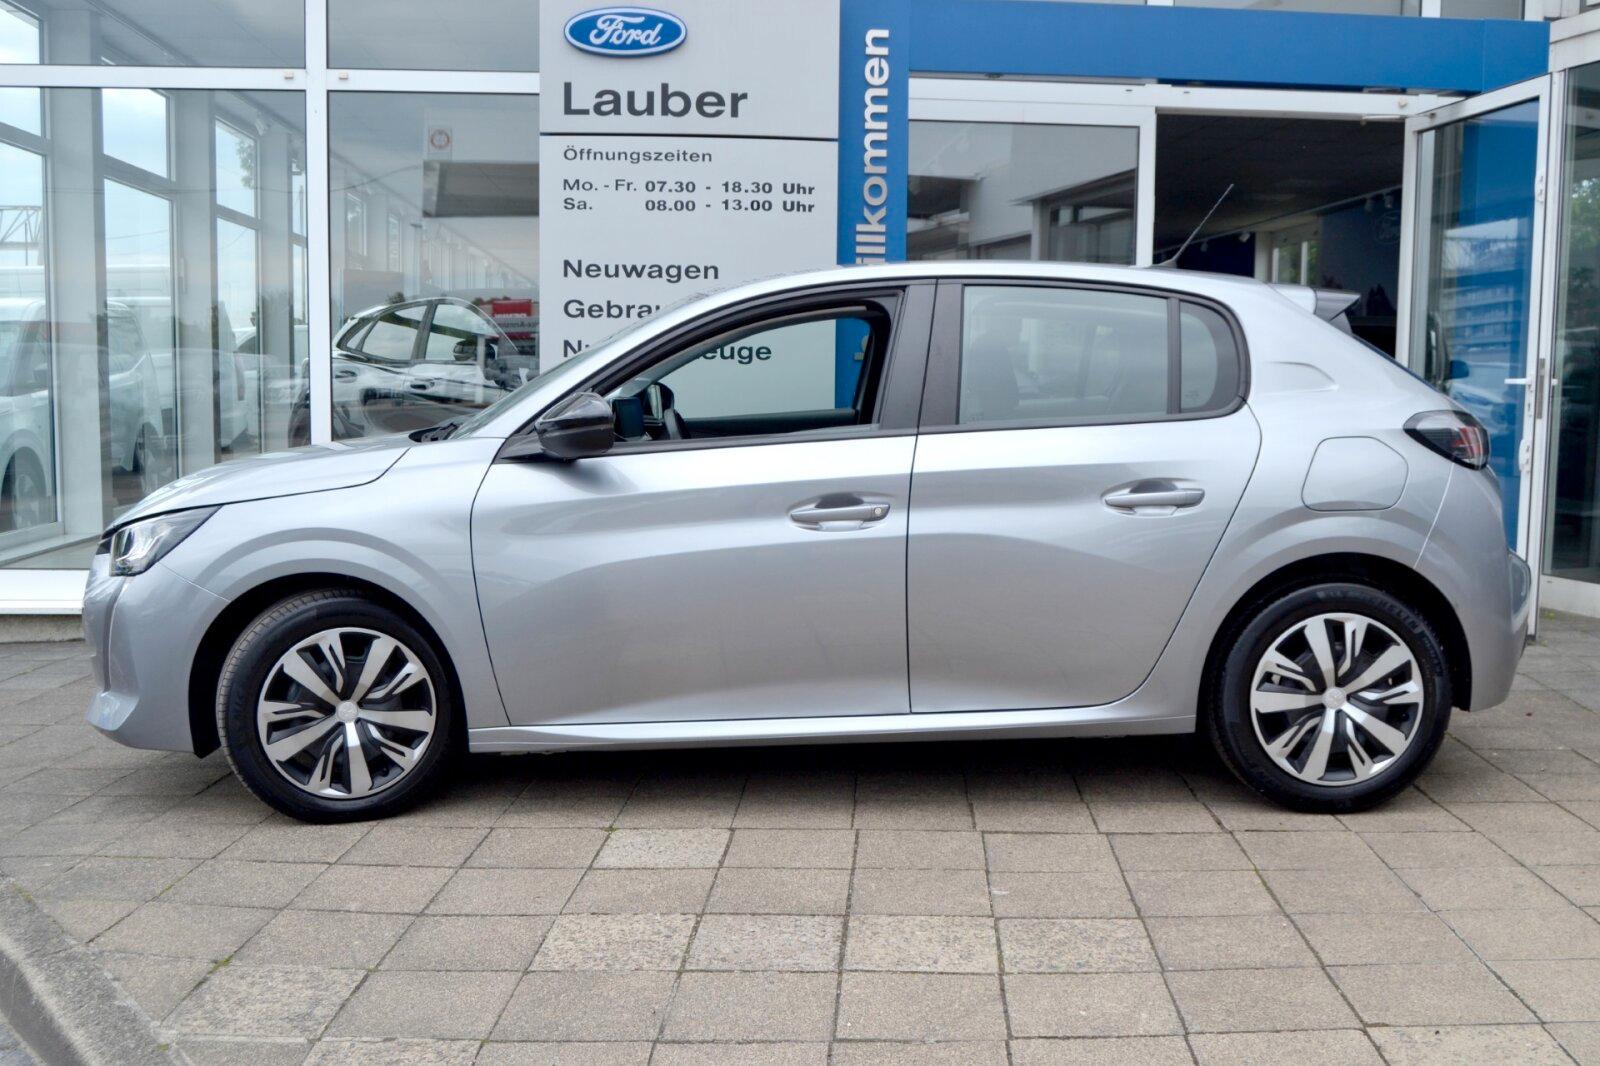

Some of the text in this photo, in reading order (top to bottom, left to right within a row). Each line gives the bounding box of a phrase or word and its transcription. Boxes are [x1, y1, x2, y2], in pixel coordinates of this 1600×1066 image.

[589, 14, 663, 45] Ford
[563, 81, 748, 118] Lauber
[563, 145, 713, 164] Öffnungszeiten
[563, 179, 598, 192] Mo.
[614, 179, 637, 192] Fr.
[645, 180, 696, 193] 07.30
[721, 181, 773, 194] 18.30
[783, 182, 816, 195] Uhr
[563, 197, 593, 211] Sa.
[645, 199, 696, 212] 08.00
[721, 199, 773, 212] 13.00
[782, 200, 815, 213] Uhr
[563, 259, 719, 284] Neuwagen
[563, 298, 661, 320] Gebra
[698, 344, 772, 365] euge
